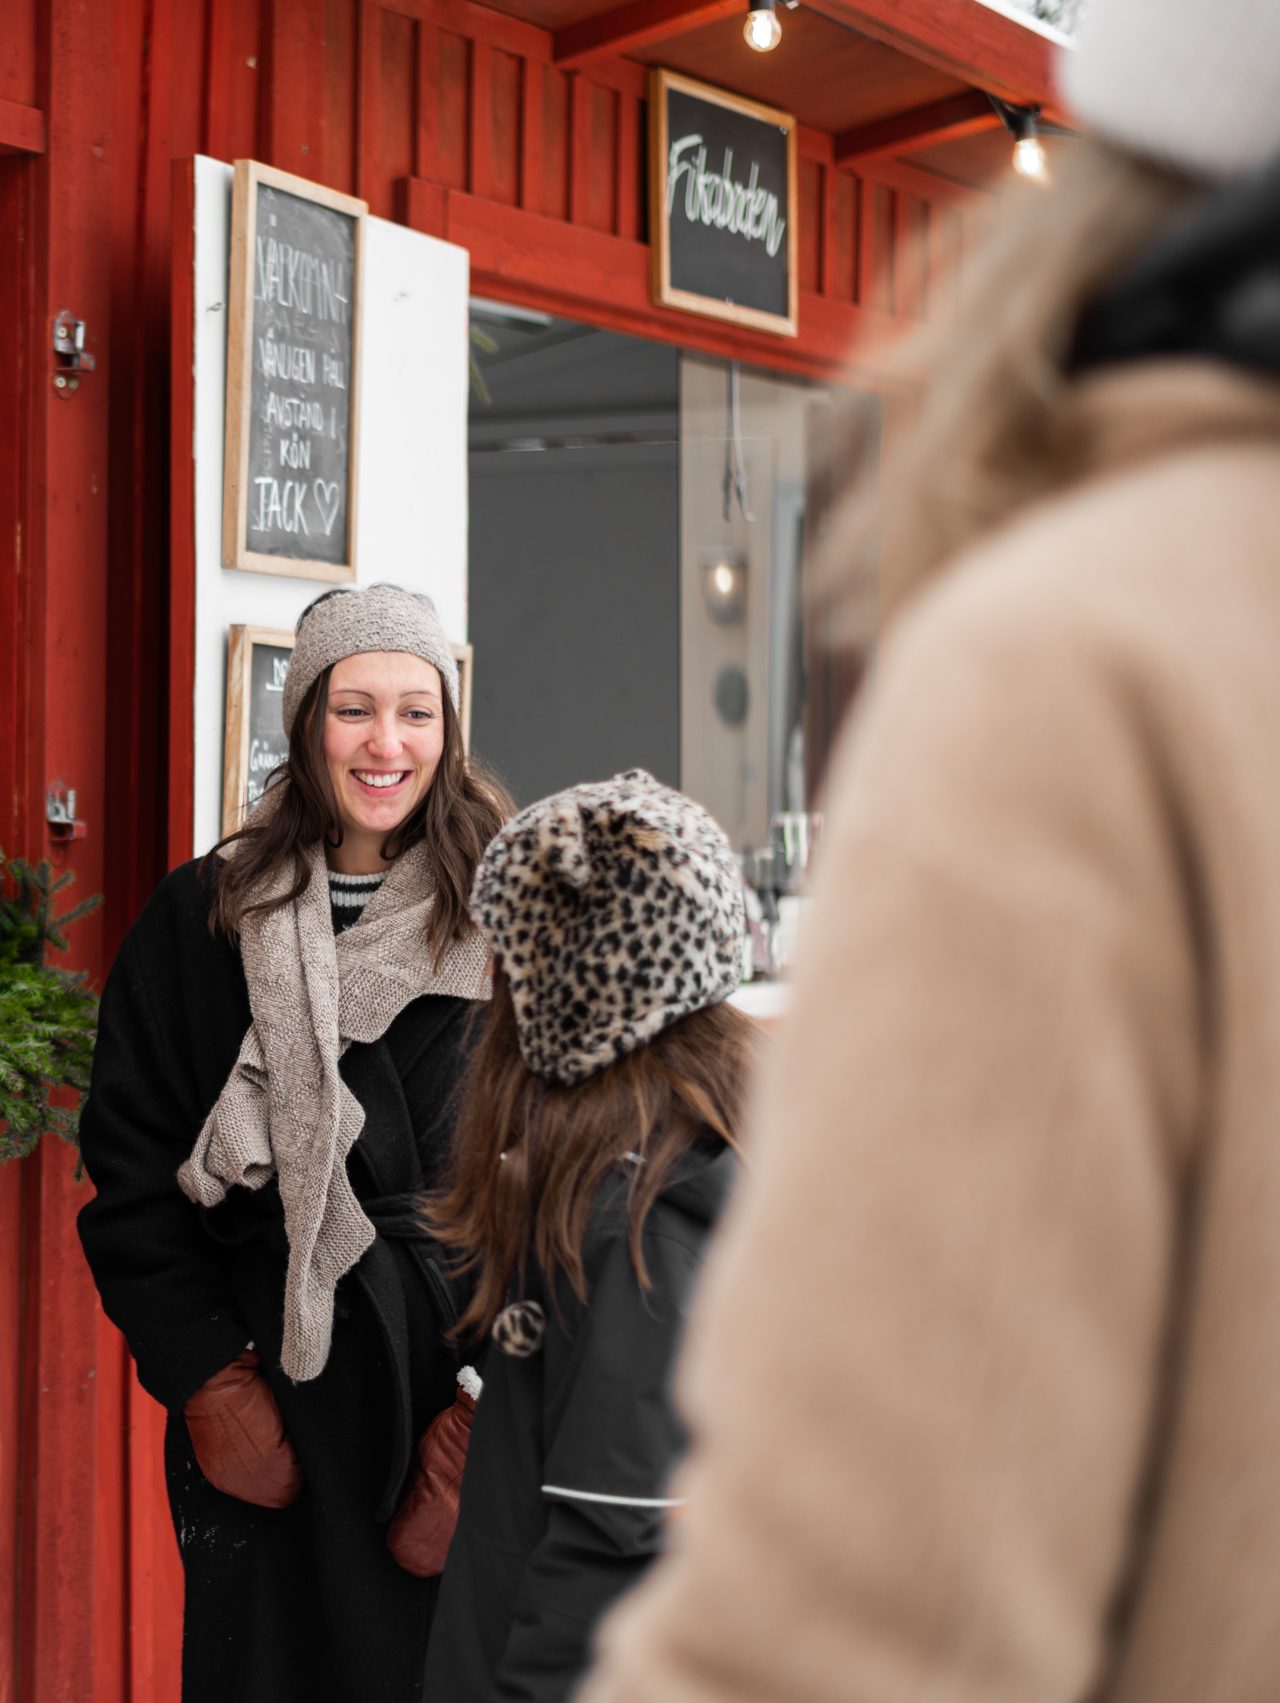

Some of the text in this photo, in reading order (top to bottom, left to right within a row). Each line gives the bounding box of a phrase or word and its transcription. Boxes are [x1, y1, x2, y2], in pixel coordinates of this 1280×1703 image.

[266, 391, 325, 432] AVSTÅND
[279, 431, 311, 470] KÖN
[254, 476, 310, 537] TACK
